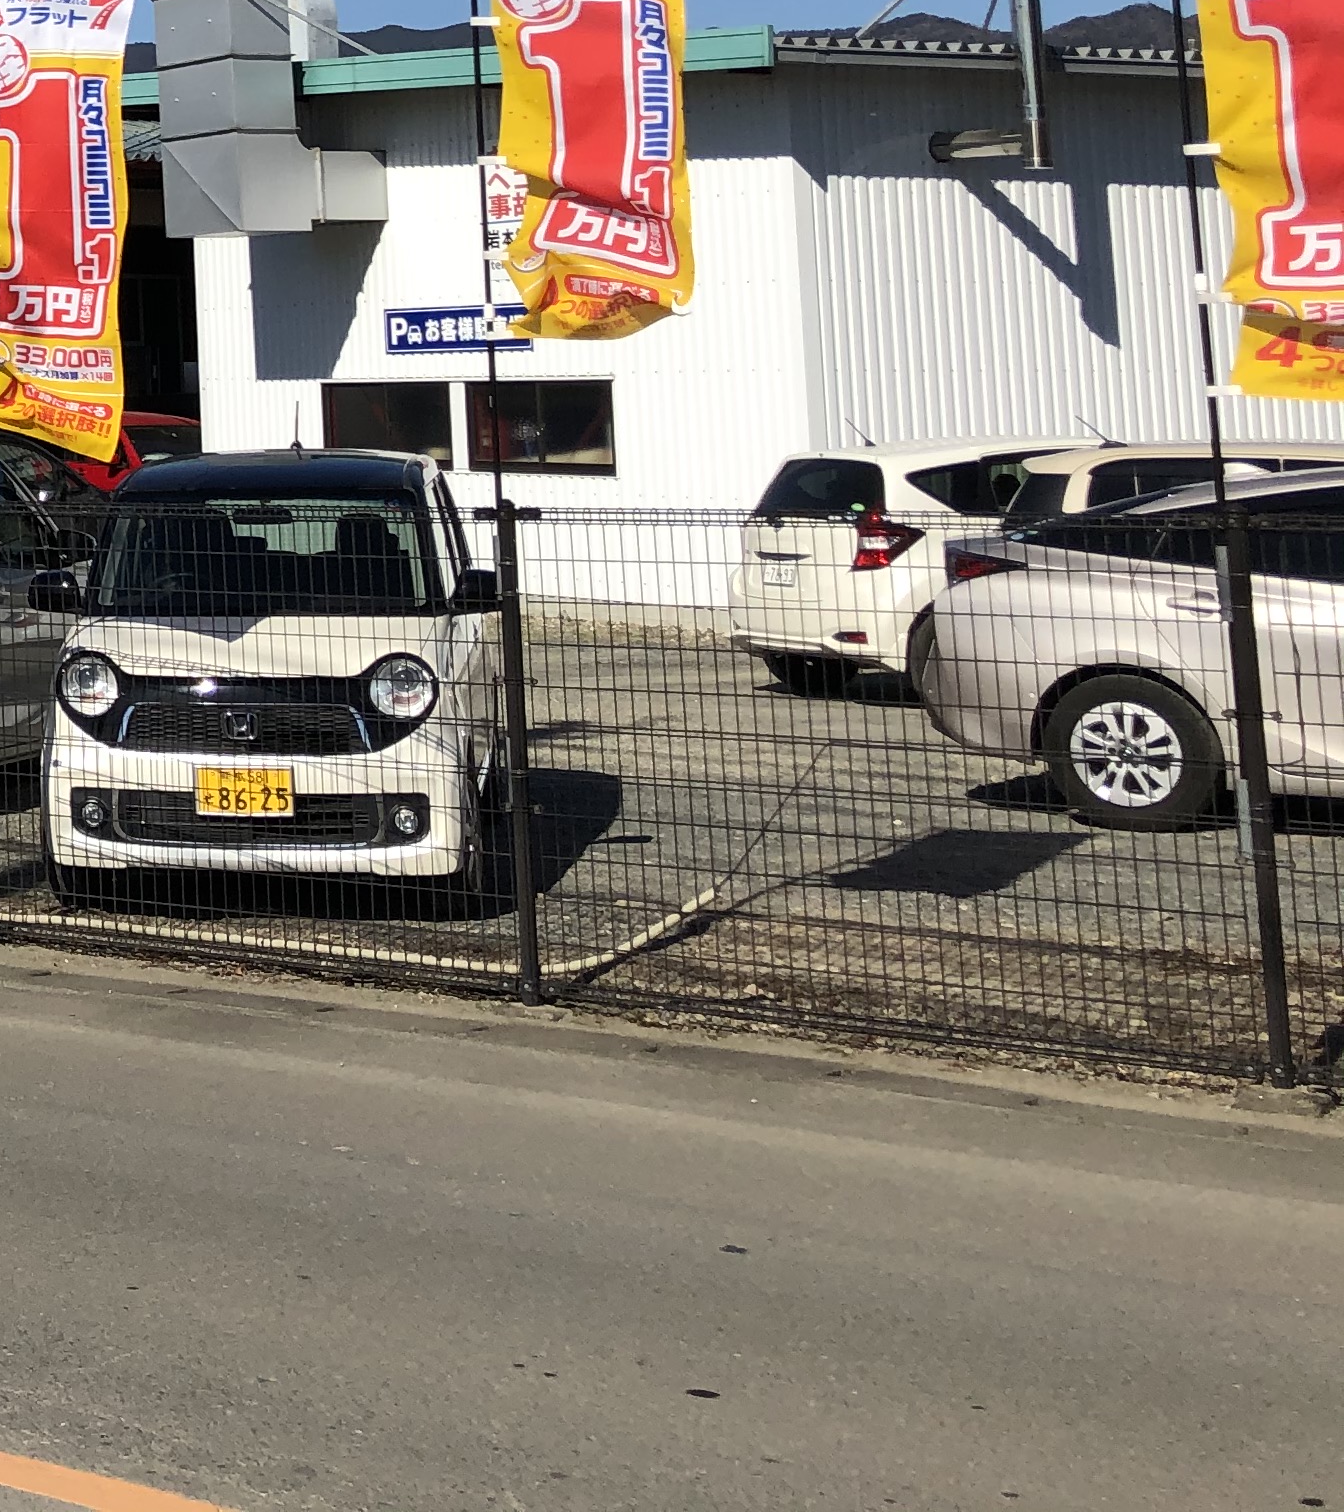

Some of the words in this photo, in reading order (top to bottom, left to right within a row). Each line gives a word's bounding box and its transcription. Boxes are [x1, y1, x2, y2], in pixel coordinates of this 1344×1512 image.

[639, 0, 669, 158] 月々コミコミ
[83, 79, 111, 225] 月々コミコミ
[557, 201, 647, 253] 万円
[7, 285, 80, 323] 万円
[390, 317, 408, 345] P
[1255, 326, 1302, 368] 4
[219, 786, 290, 811] 86-25
